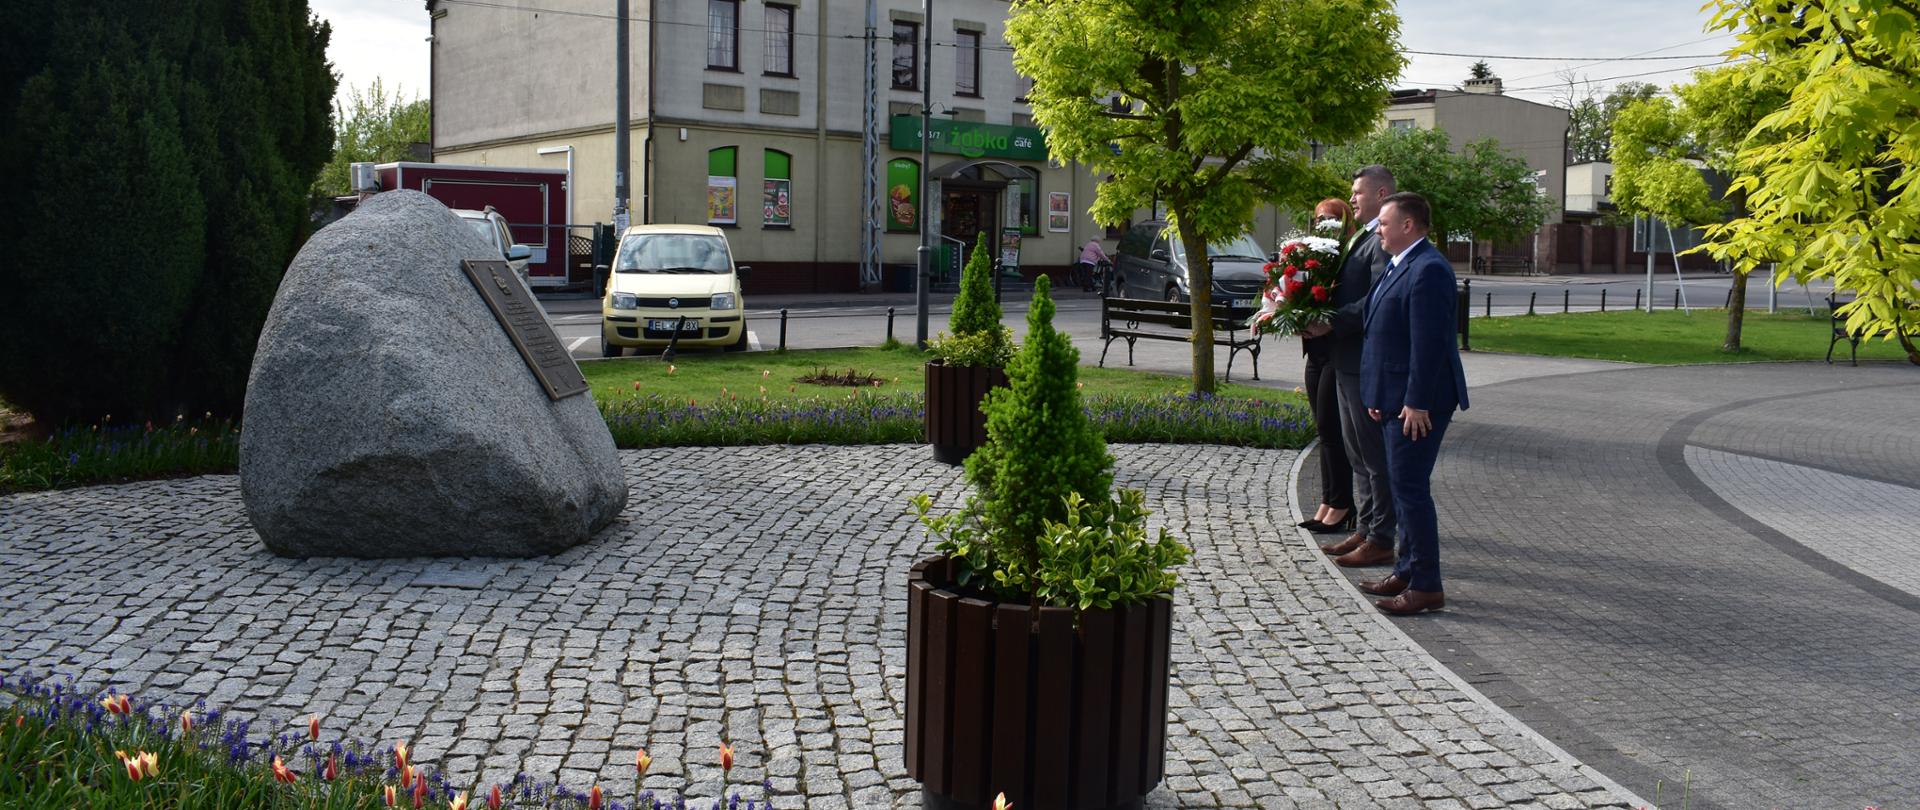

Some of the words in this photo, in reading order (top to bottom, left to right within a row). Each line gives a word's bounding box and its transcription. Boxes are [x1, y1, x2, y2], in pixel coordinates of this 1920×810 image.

[951, 127, 1007, 150] żabka
[1014, 137, 1032, 148] café
[670, 321, 697, 330] 48X
